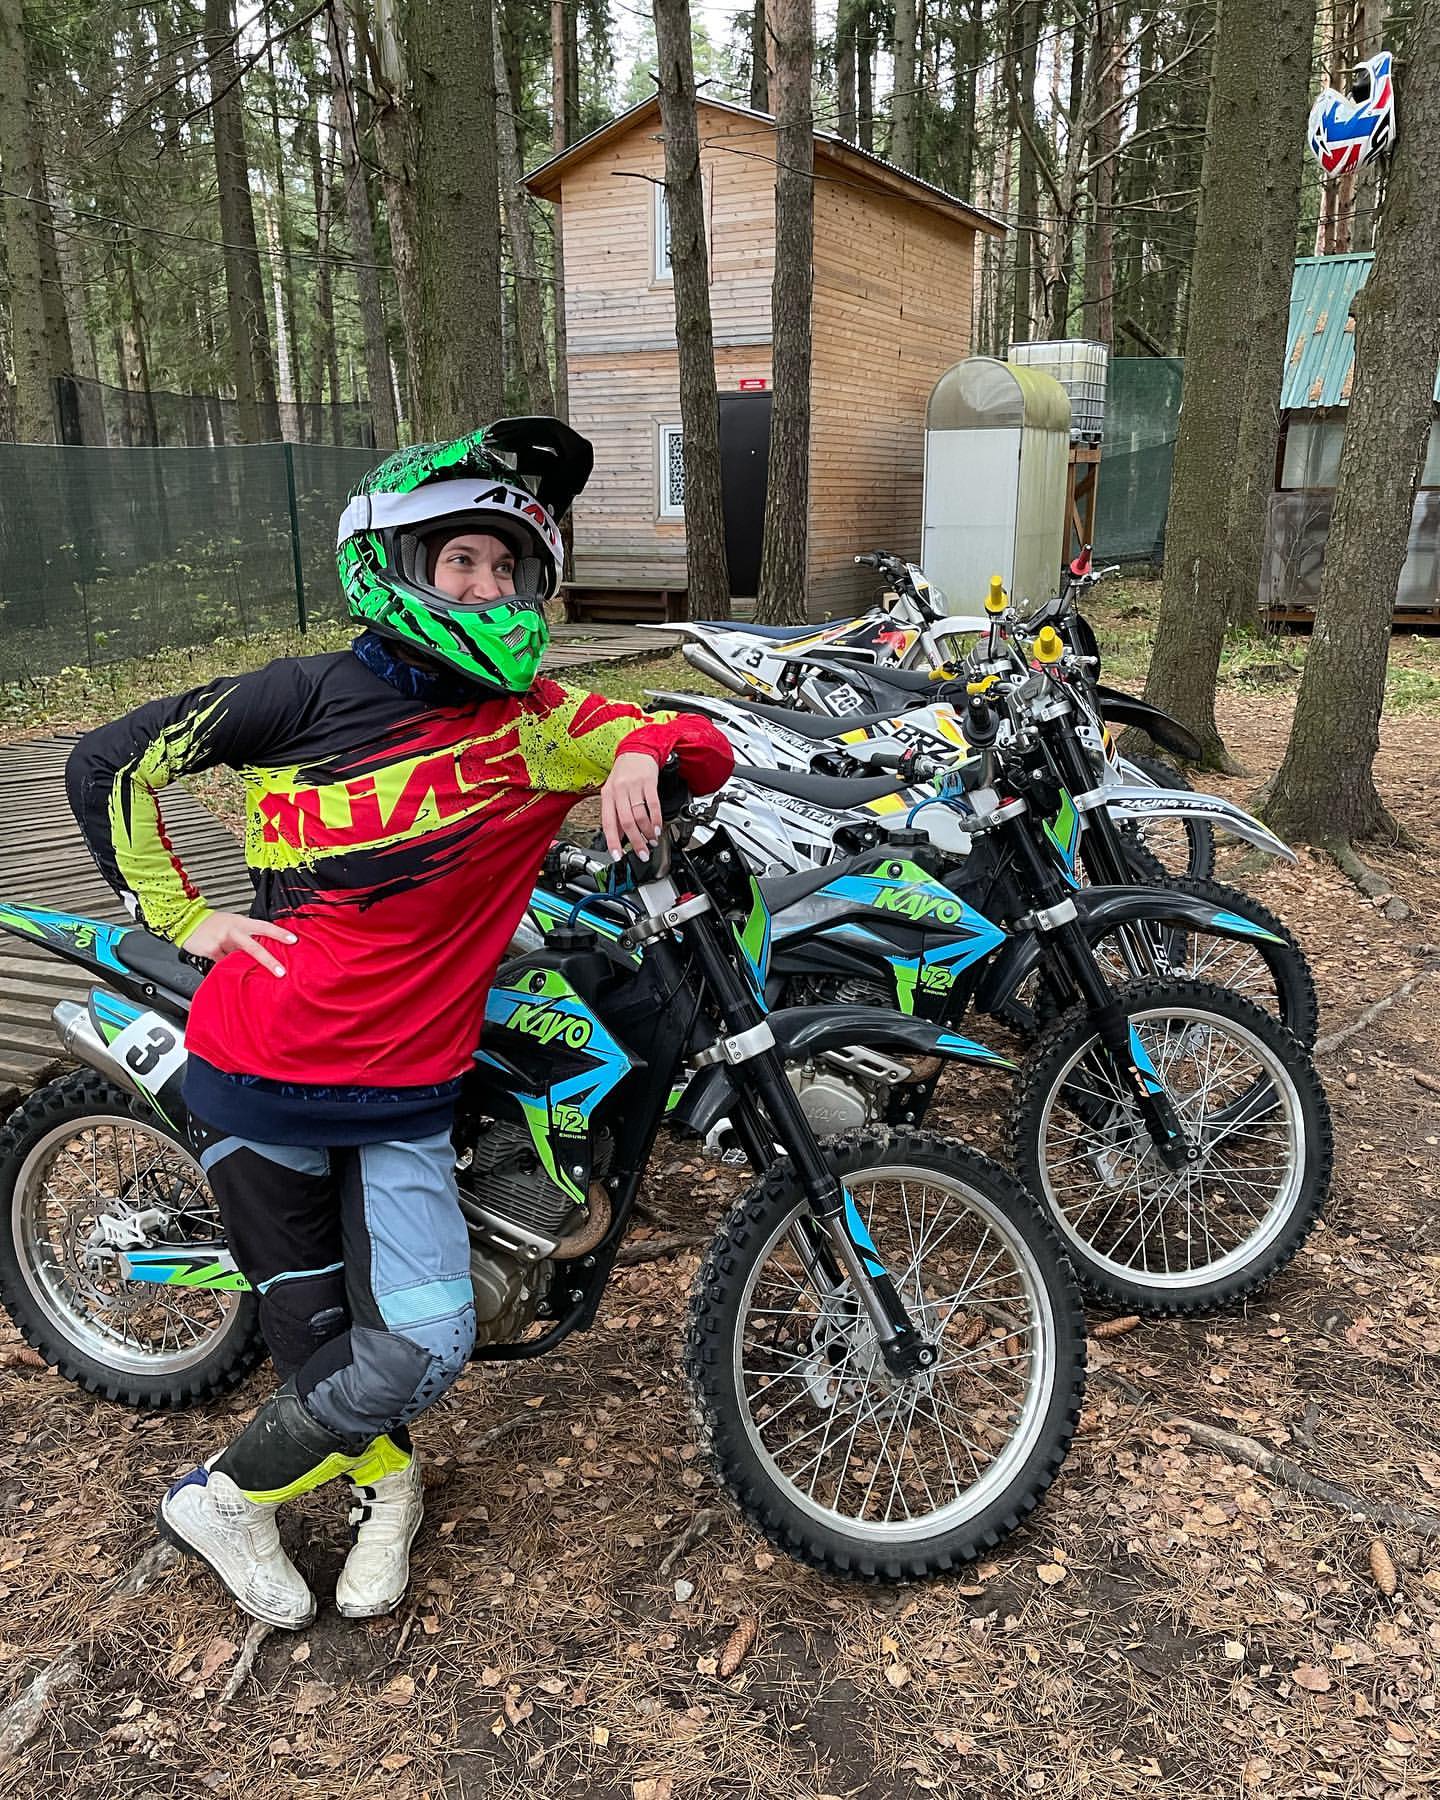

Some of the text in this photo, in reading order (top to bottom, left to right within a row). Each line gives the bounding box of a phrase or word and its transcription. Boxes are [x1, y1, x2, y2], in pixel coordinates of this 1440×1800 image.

[806, 806, 841, 828] TEAM
[1119, 799, 1225, 812] RACING TEAM
[871, 886, 962, 924] KAYO
[925, 964, 952, 990] T2
[506, 1002, 592, 1049] KAYO
[126, 1026, 176, 1076] 3
[556, 1103, 584, 1133] T2
